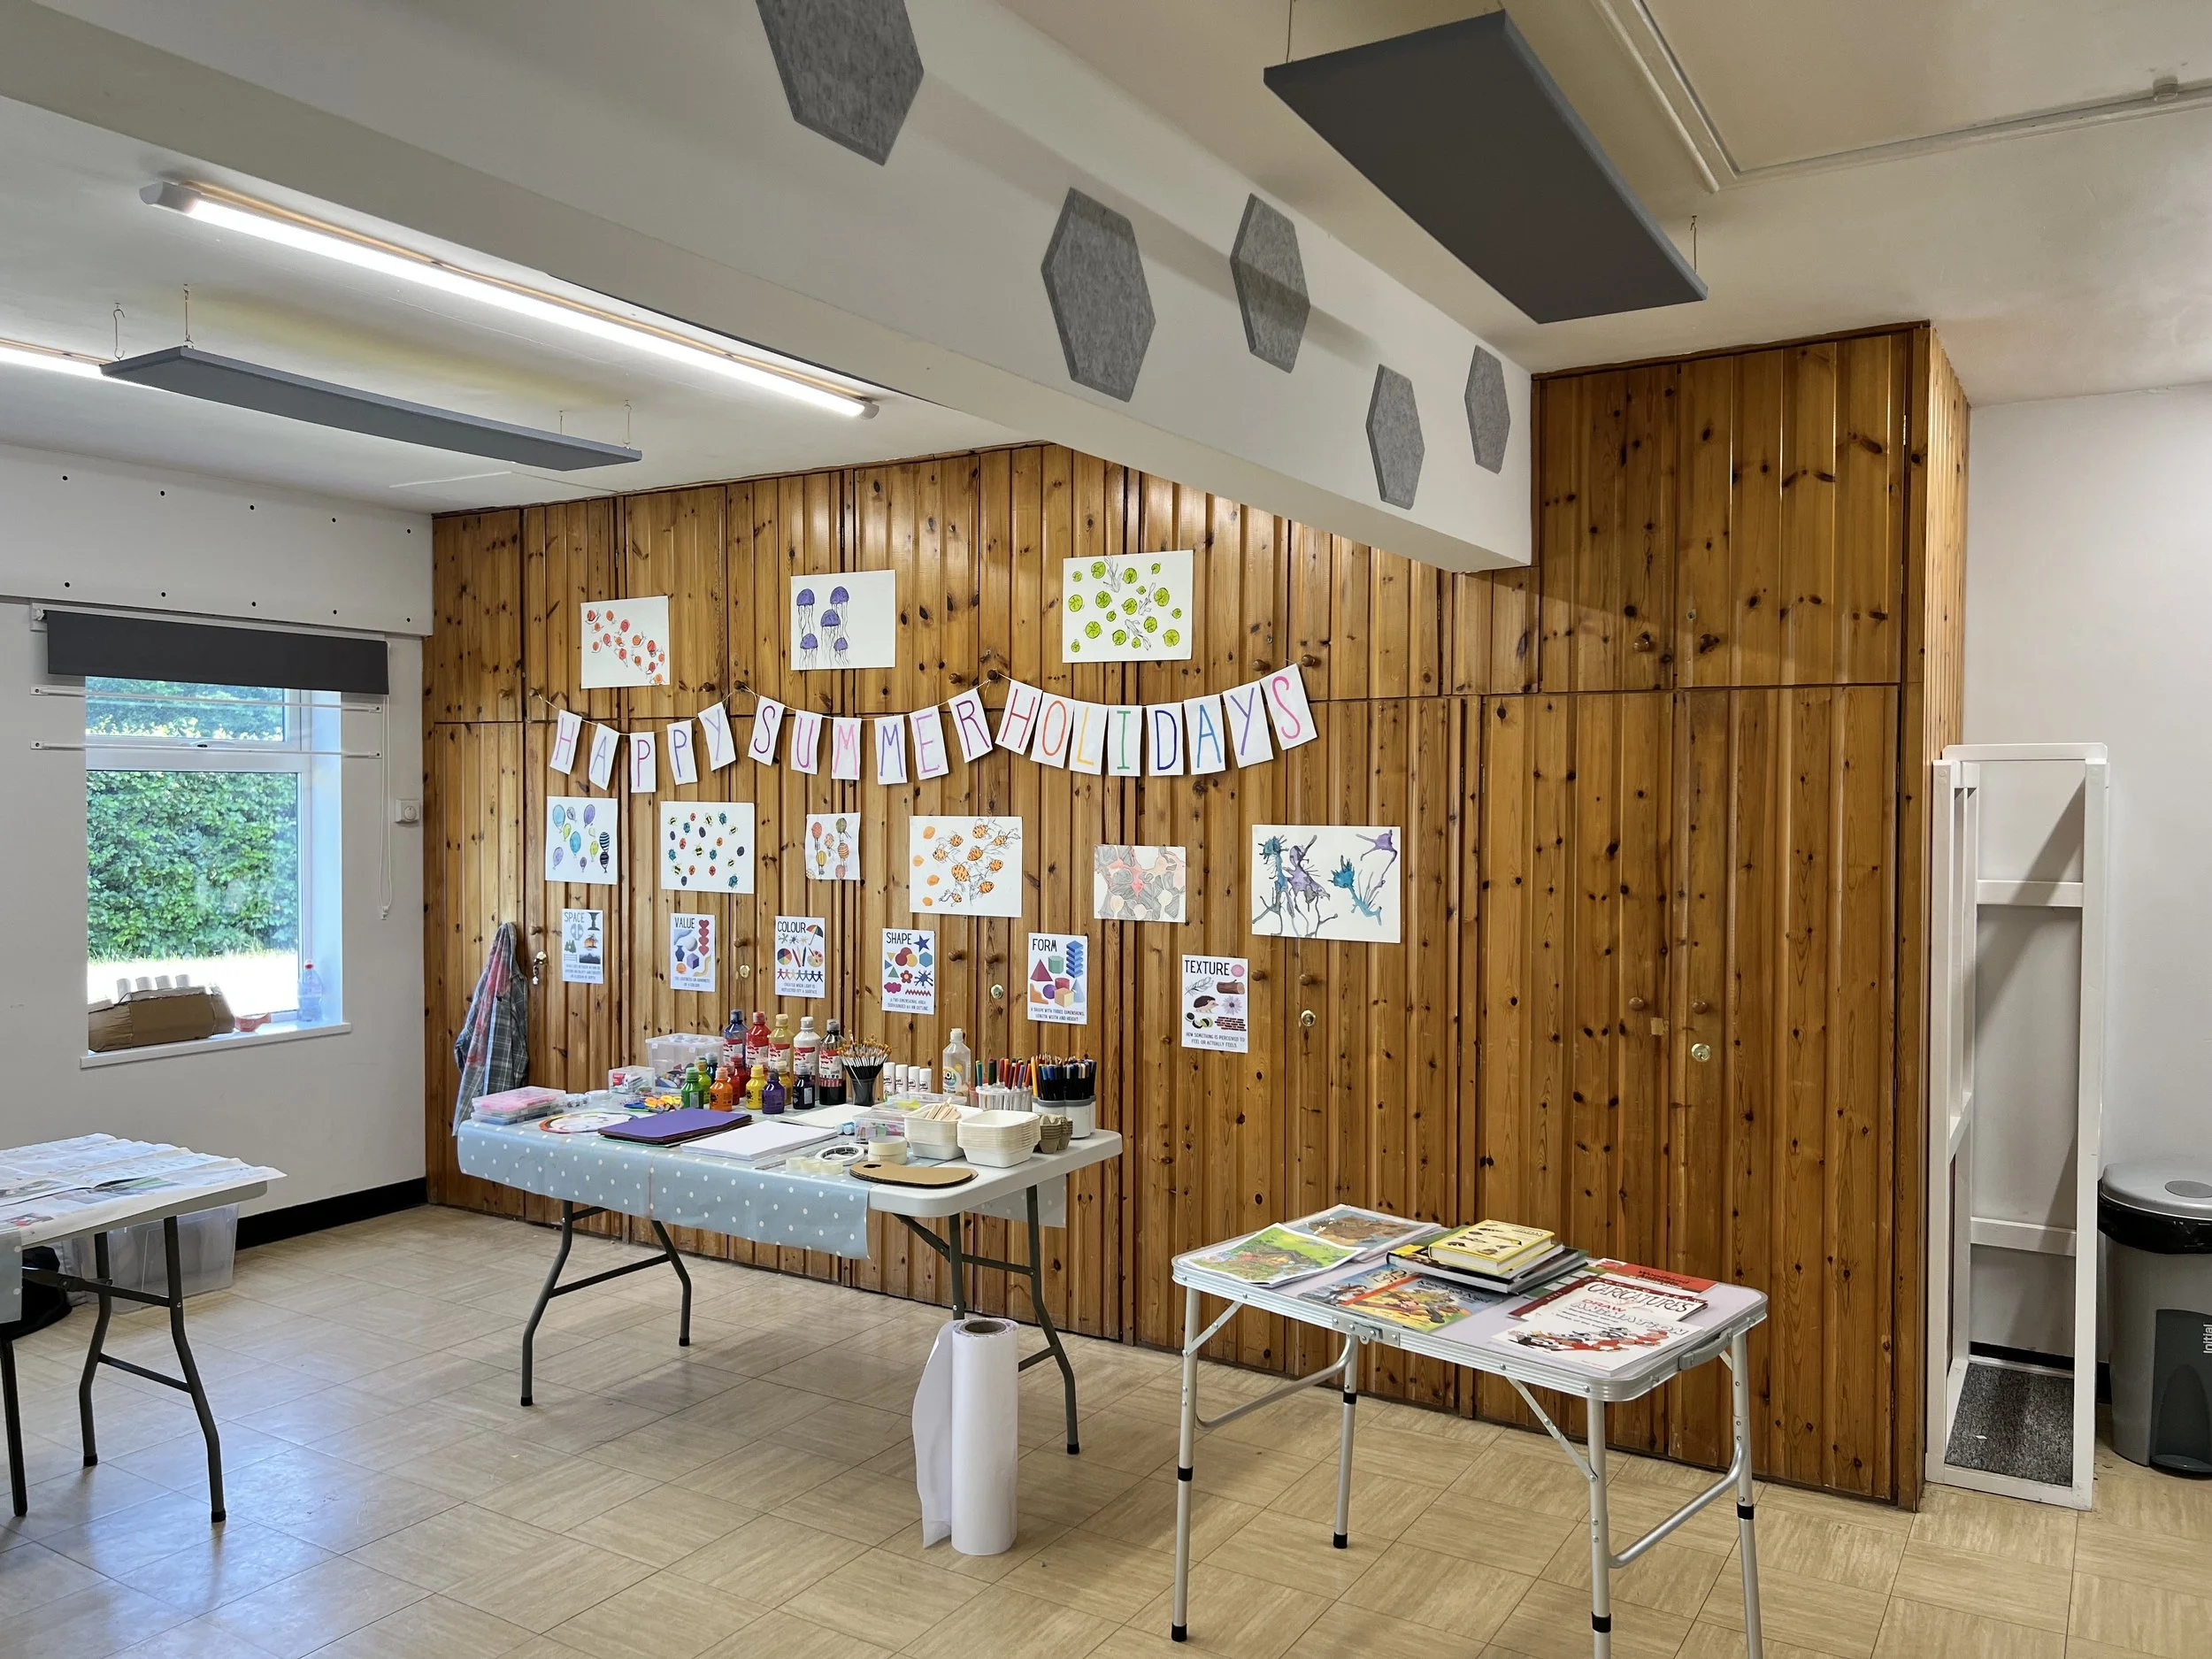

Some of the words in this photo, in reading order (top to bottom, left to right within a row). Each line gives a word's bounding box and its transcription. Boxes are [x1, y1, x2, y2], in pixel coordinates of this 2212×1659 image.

[554, 708, 722, 787] HAPPY
[754, 700, 991, 779] SUMMER
[1002, 676, 1301, 771] HOLIDAYS
[564, 911, 585, 923] SPACE
[674, 917, 695, 929] VALUE
[777, 920, 806, 933] COLOUR
[886, 932, 912, 945] SHAPE
[1032, 938, 1057, 952] FORM
[1184, 959, 1230, 976] TEXTURE
[1586, 1282, 1694, 1314] CARICATURES
[1582, 1299, 1626, 1312] DRAW
[1571, 1302, 1689, 1335] ANIMATION
[2202, 1324, 2212, 1354] Initial
